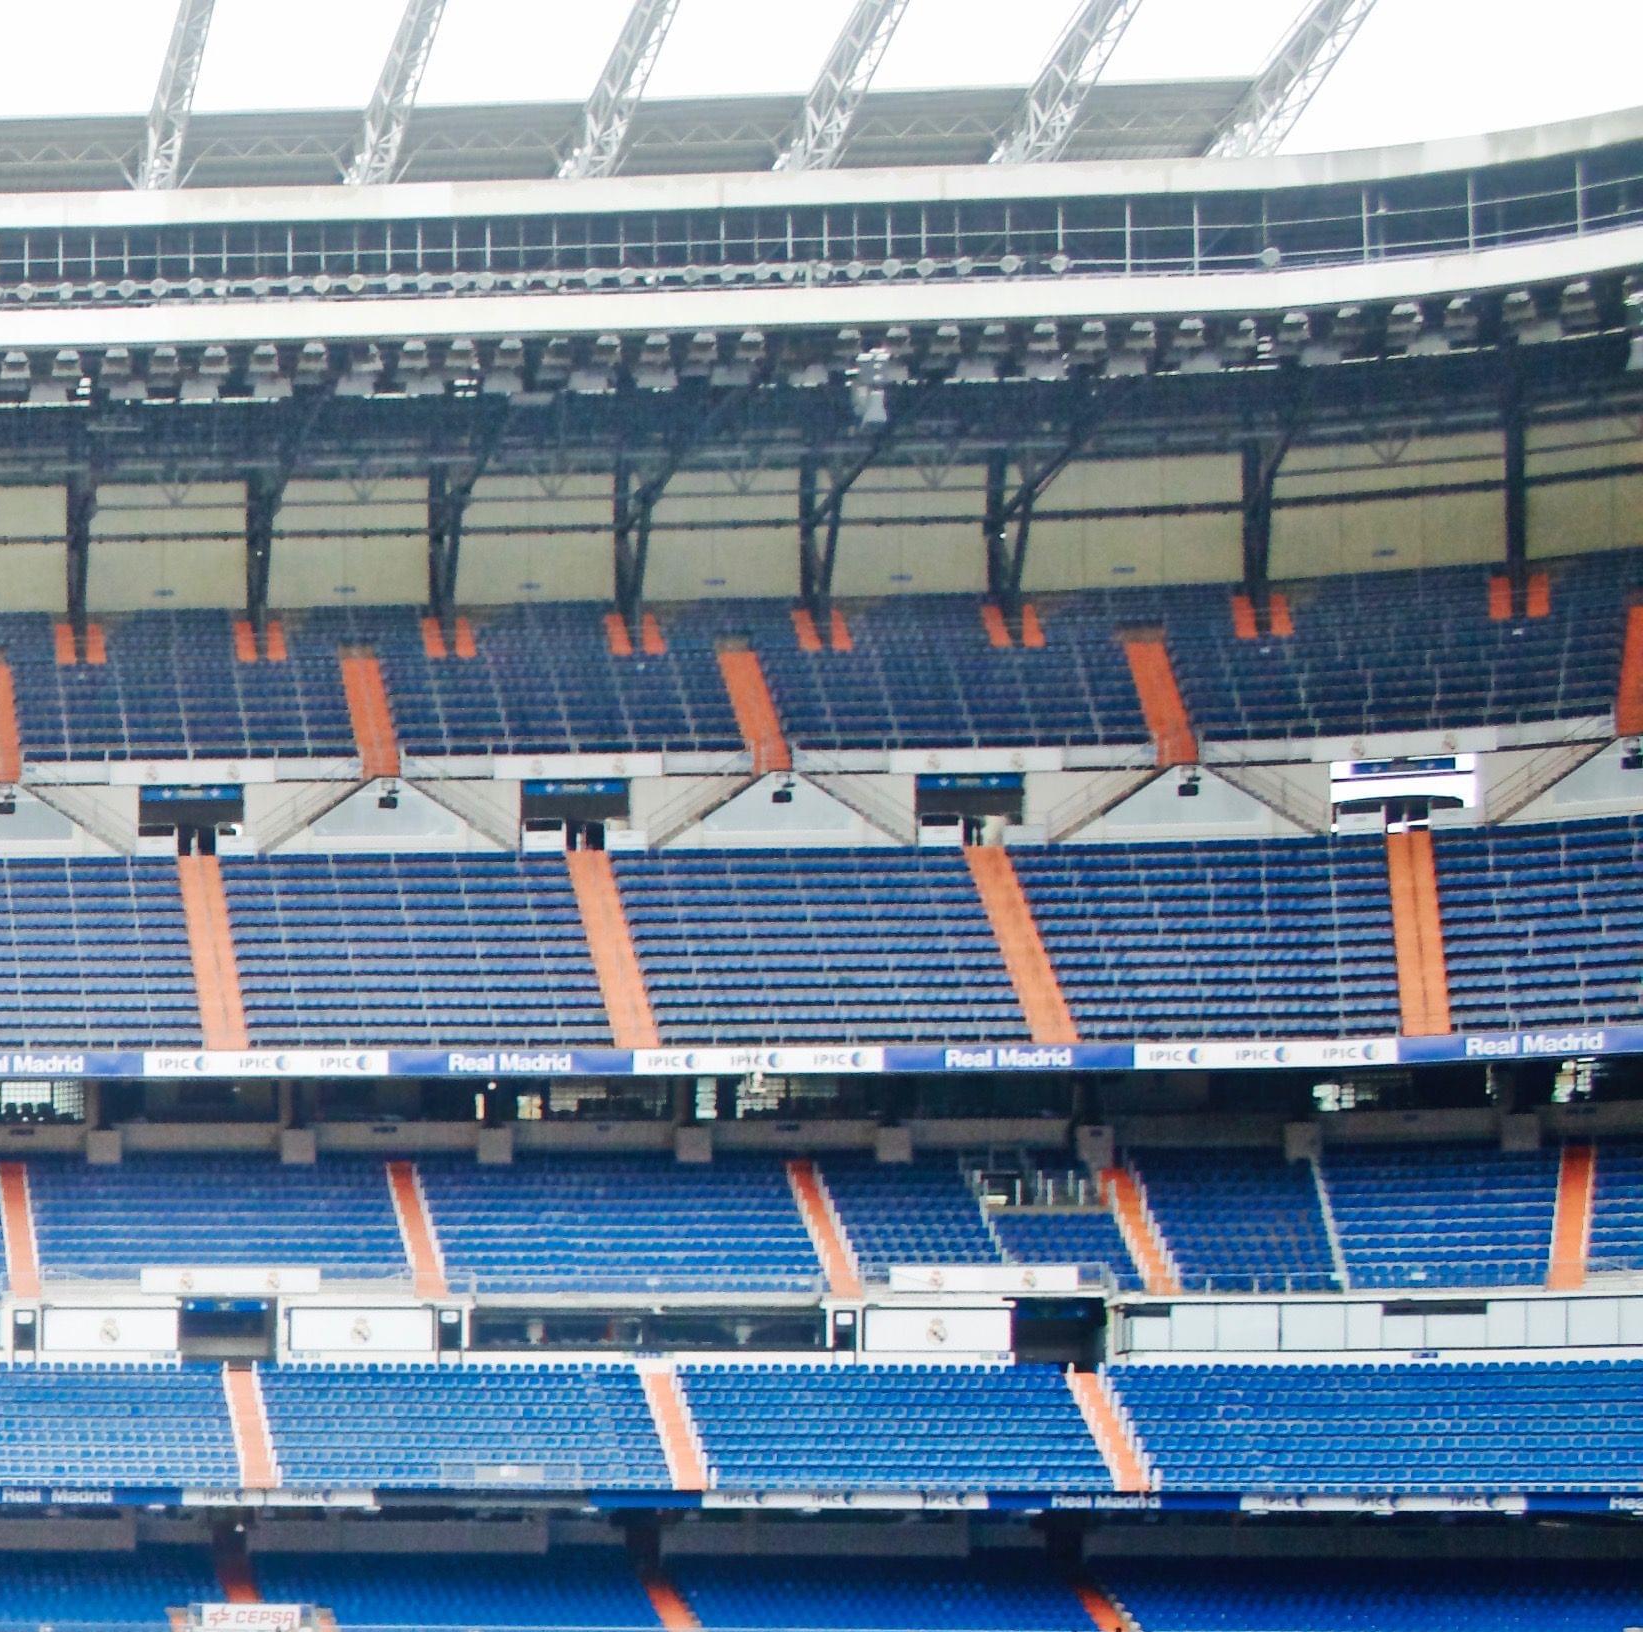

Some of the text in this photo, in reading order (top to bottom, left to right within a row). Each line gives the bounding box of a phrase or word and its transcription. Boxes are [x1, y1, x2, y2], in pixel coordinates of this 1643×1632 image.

[1467, 1032, 1607, 1057] Real Madrid
[648, 1056, 679, 1067] IPIC
[814, 1054, 845, 1065] IPIC
[947, 1047, 1071, 1068] Real Madrid
[1150, 1047, 1356, 1062] IPIC IPIC IPIC
[14, 1055, 83, 1073] Madrid
[159, 1057, 351, 1069] IPIC IPIC IPIC
[450, 1053, 572, 1074] Real Madrid
[1611, 1496, 1643, 1512] Rea
[235, 1609, 296, 1623] CEPSA
